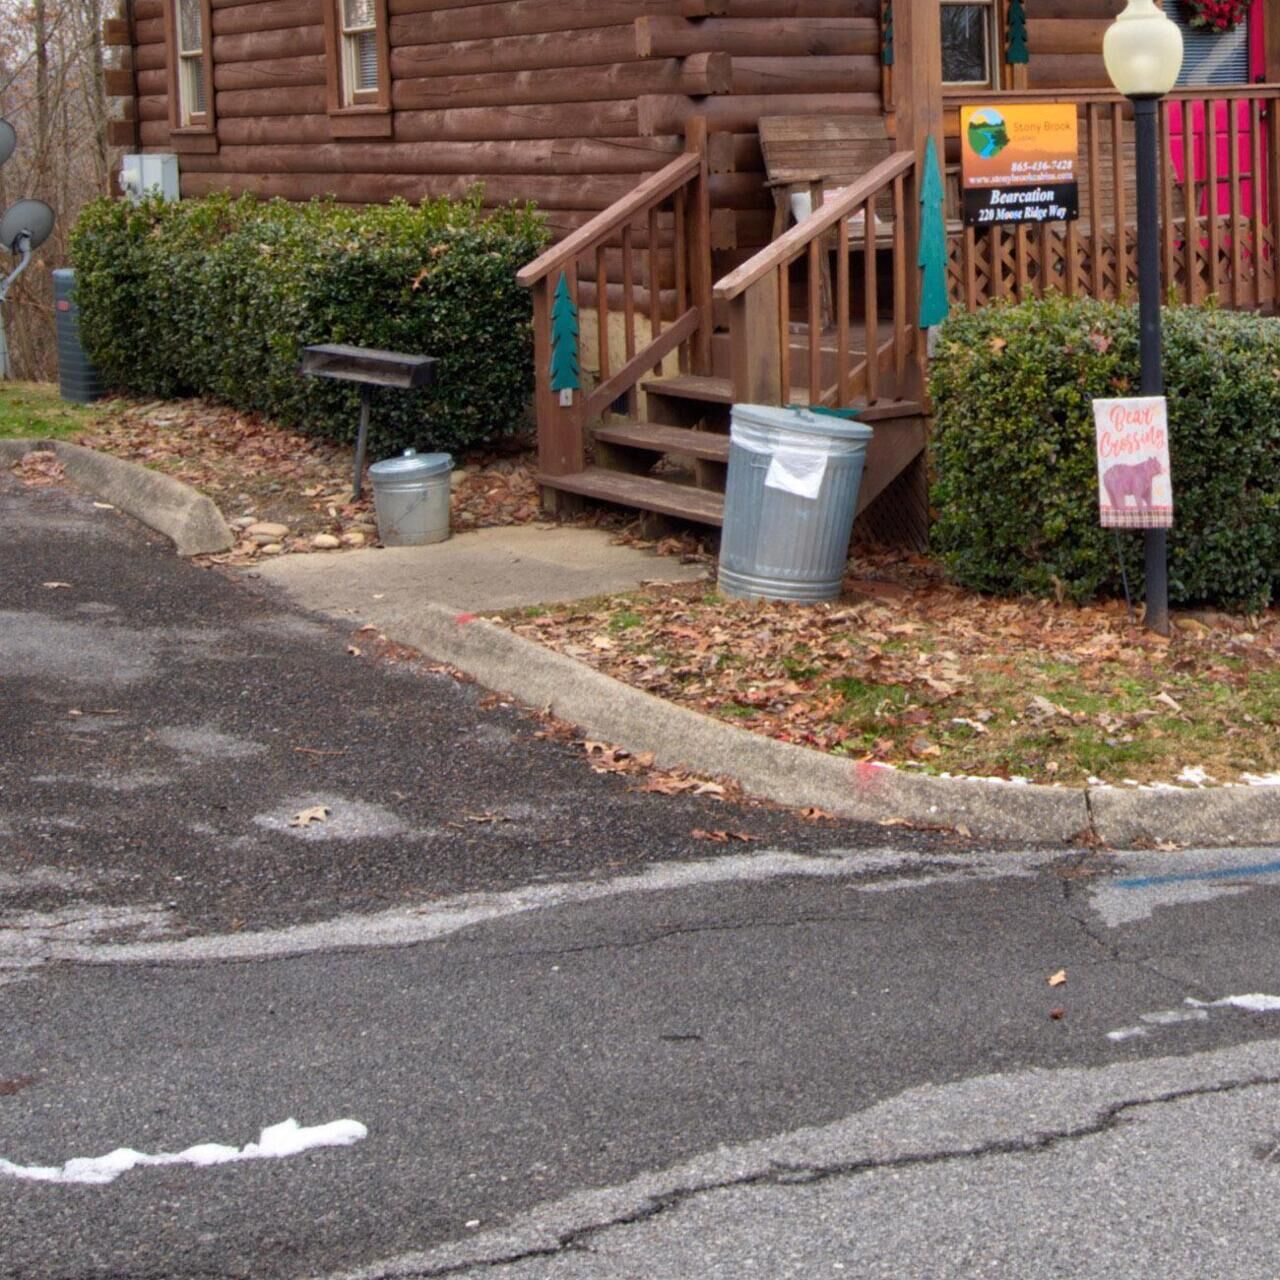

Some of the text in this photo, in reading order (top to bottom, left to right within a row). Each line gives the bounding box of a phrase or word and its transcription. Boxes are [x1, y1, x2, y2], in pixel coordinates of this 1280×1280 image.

[1014, 121, 1071, 133] Stony Brook
[990, 187, 1055, 205] Bearcation
[978, 205, 1067, 222] 220 Moose Ridge Way
[1109, 404, 1153, 432] Bear
[1099, 426, 1165, 458] Crossing
